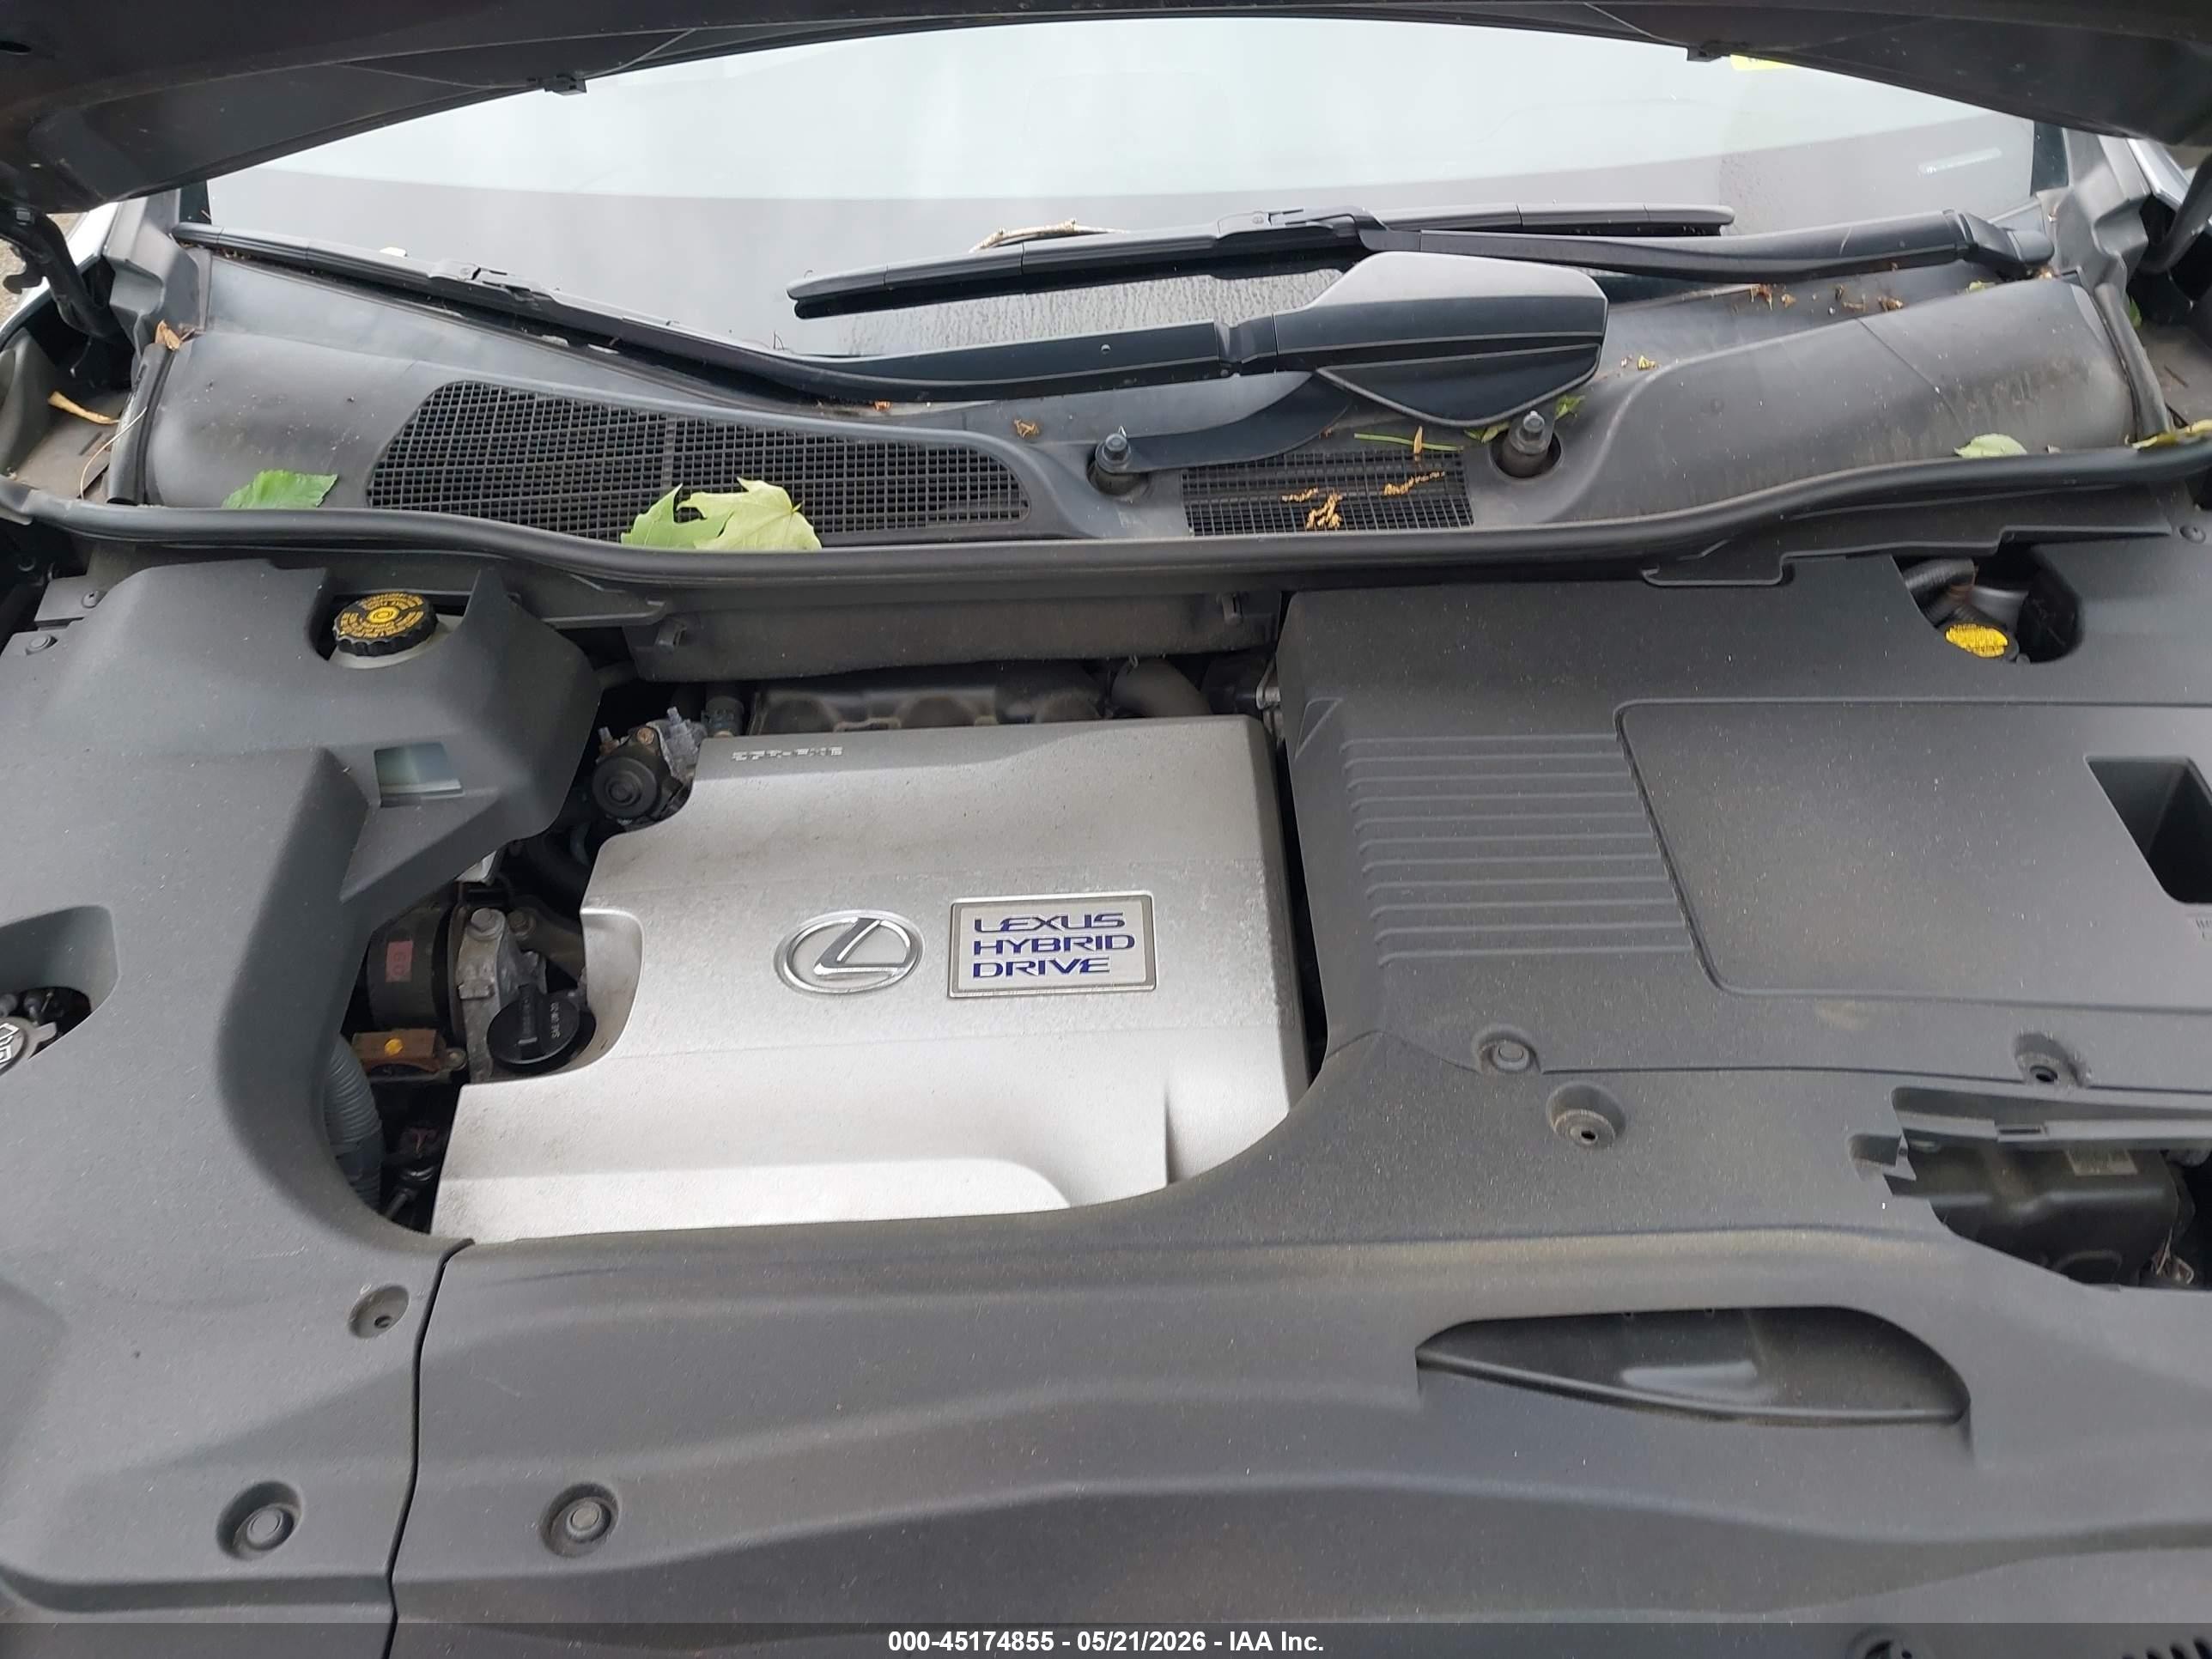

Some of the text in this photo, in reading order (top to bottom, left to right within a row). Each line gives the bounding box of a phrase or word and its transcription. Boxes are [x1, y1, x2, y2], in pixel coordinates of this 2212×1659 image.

[974, 912, 1126, 933] LEXUS
[973, 933, 1135, 955] HYBRID
[973, 957, 1110, 978] DRIVE
